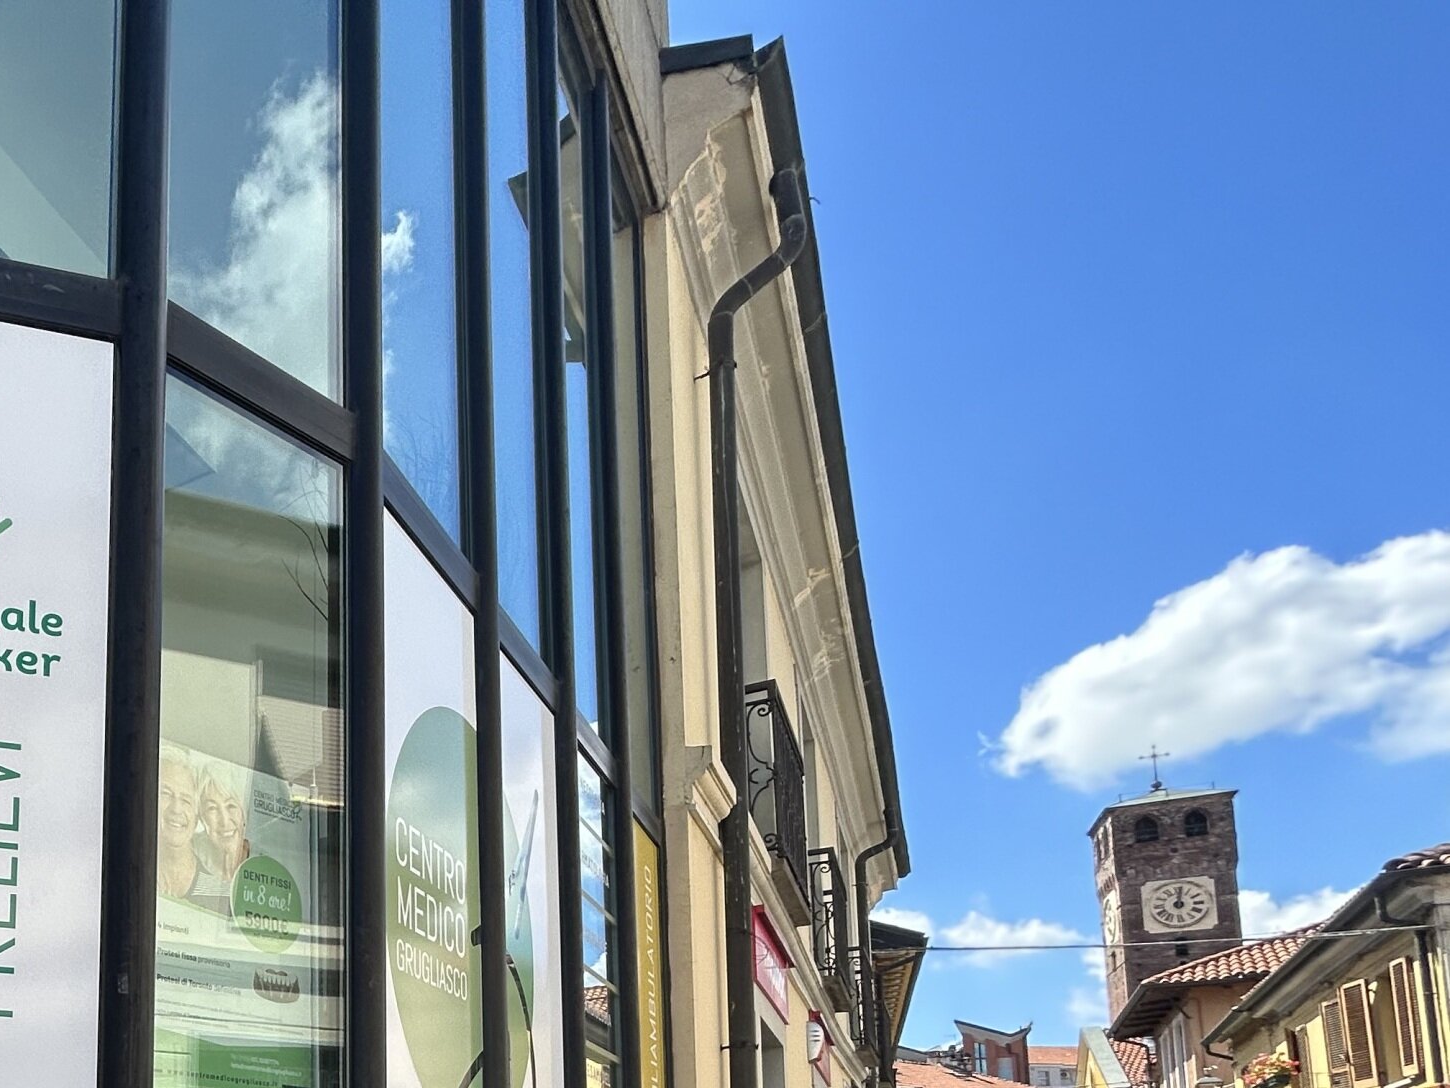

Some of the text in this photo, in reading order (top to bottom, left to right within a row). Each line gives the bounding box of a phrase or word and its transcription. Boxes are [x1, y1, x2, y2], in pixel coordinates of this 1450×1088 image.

[244, 870, 292, 890] DENTI FISSI
[395, 817, 466, 905] CENTRO
[258, 885, 266, 905] 8
[397, 875, 466, 959] MEDICO
[396, 938, 468, 1001] GRUGLIASCO
